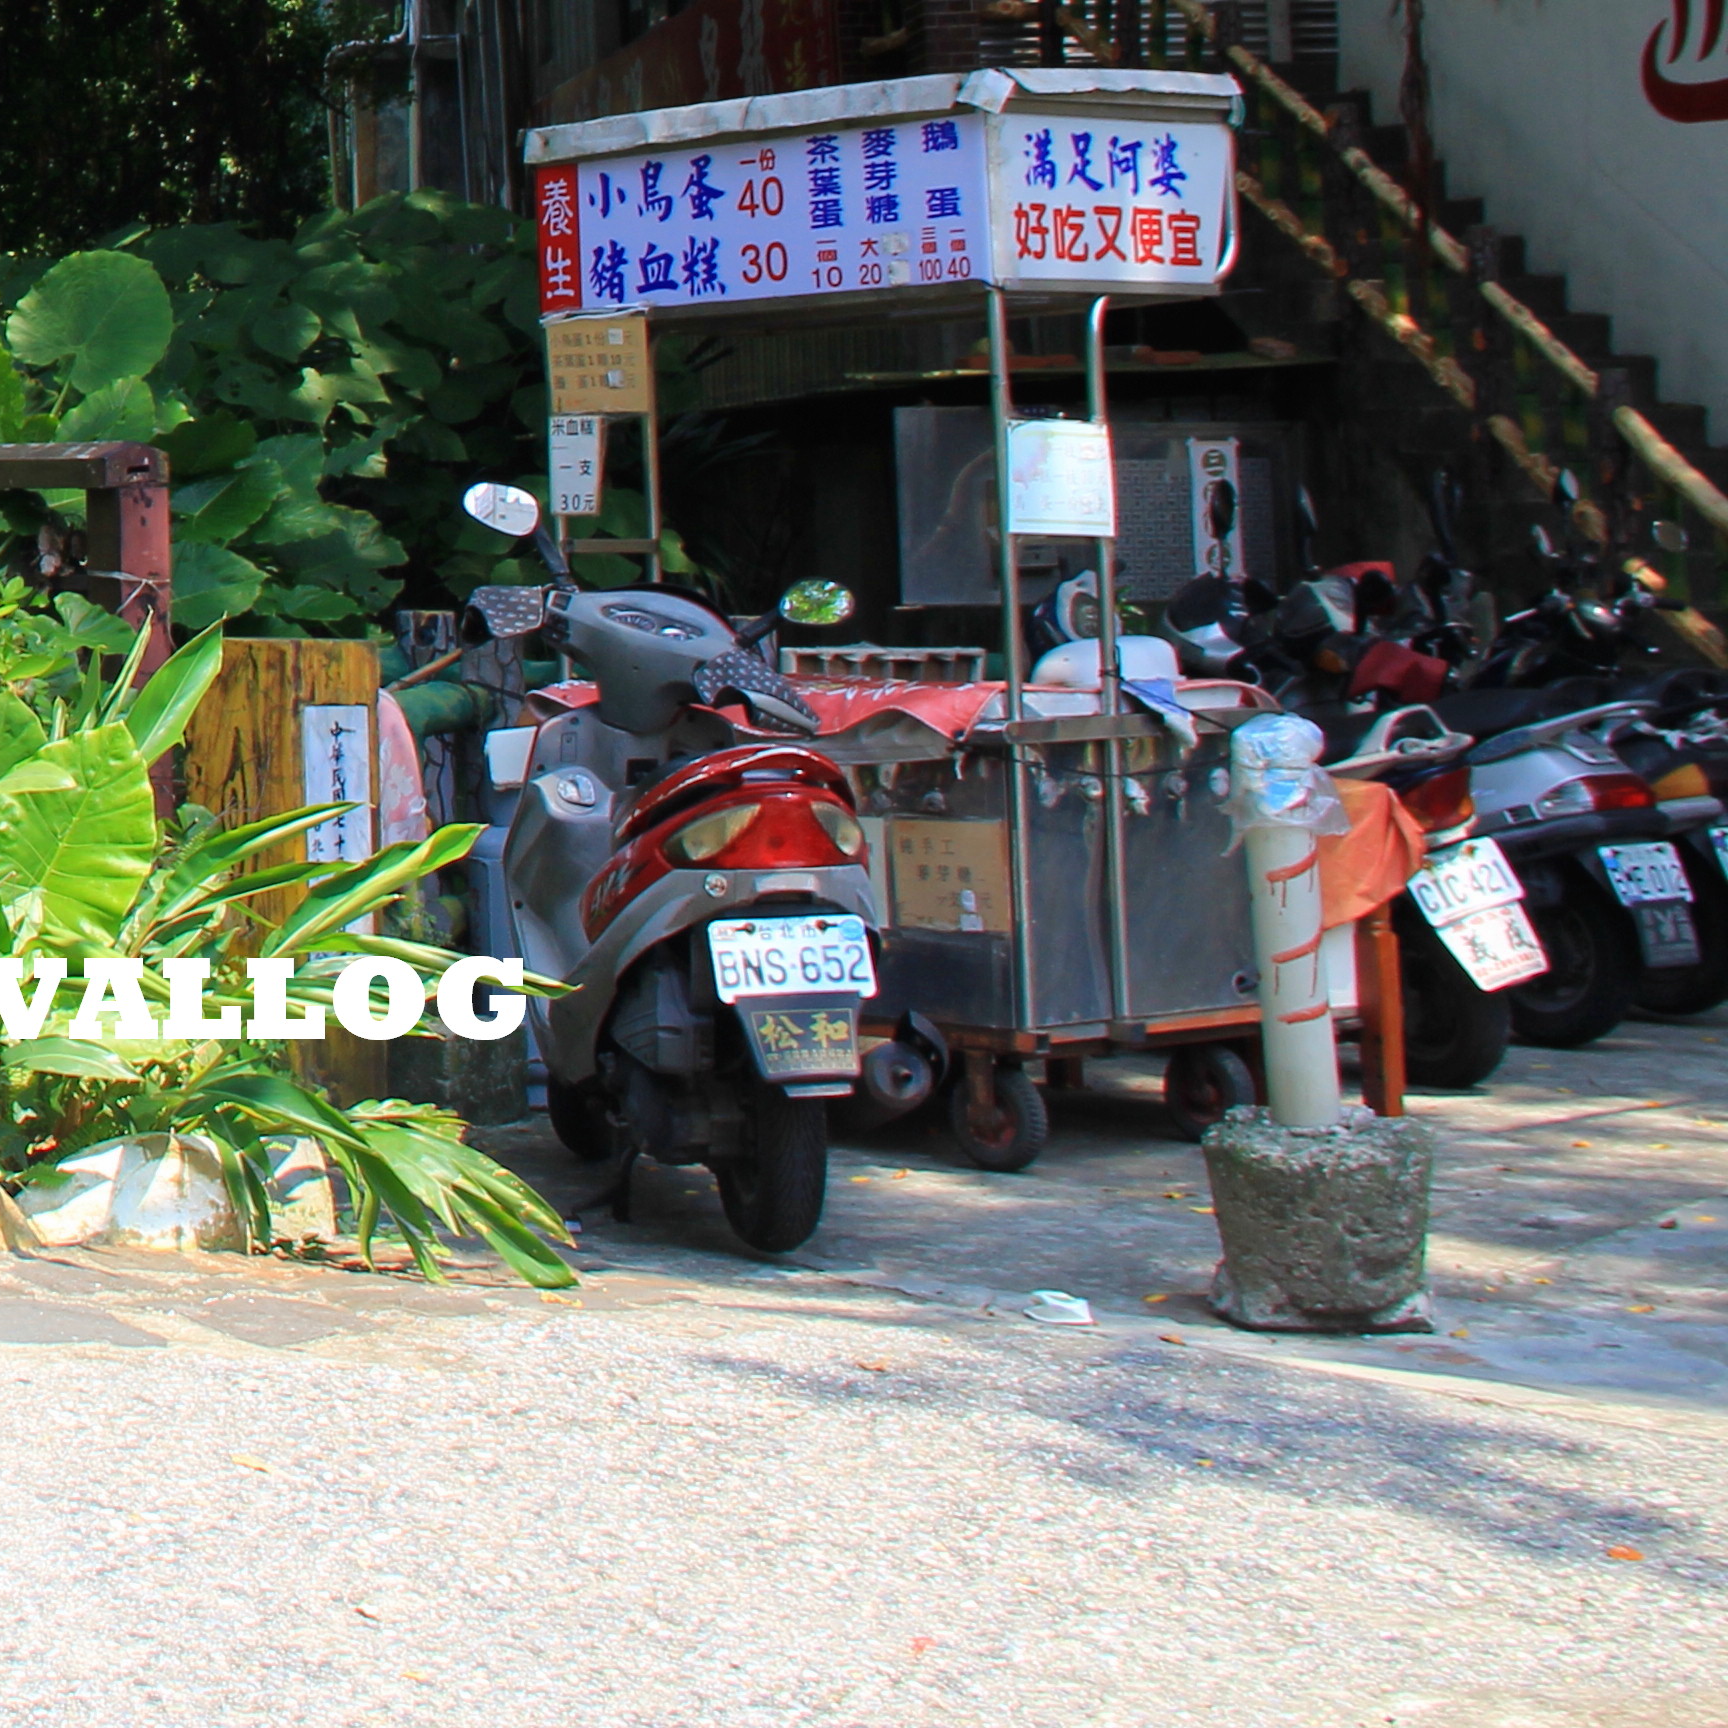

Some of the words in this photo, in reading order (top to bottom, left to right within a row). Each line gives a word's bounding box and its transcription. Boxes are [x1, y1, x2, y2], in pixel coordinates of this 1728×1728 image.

[739, 148, 776, 171] 一份
[861, 128, 899, 224] 麥芽糖
[1024, 128, 1187, 198] 滿足阿婆
[588, 154, 725, 222] 小鳥蛋
[737, 176, 784, 218] 40
[806, 135, 844, 229] 茶葉蛋
[542, 178, 575, 299] 養生
[860, 239, 879, 258] 大
[1014, 202, 1203, 266] 好吃又便宜
[590, 235, 726, 304] 豬血糕
[740, 241, 788, 284] 30
[811, 267, 843, 289] 10
[859, 264, 882, 286] 20
[919, 259, 943, 281] 100
[947, 256, 971, 278] 40
[552, 419, 593, 436] 米血糕
[560, 494, 594, 512] 30元
[717, 944, 869, 989] BNS-652
[758, 1014, 850, 1053] 松和
